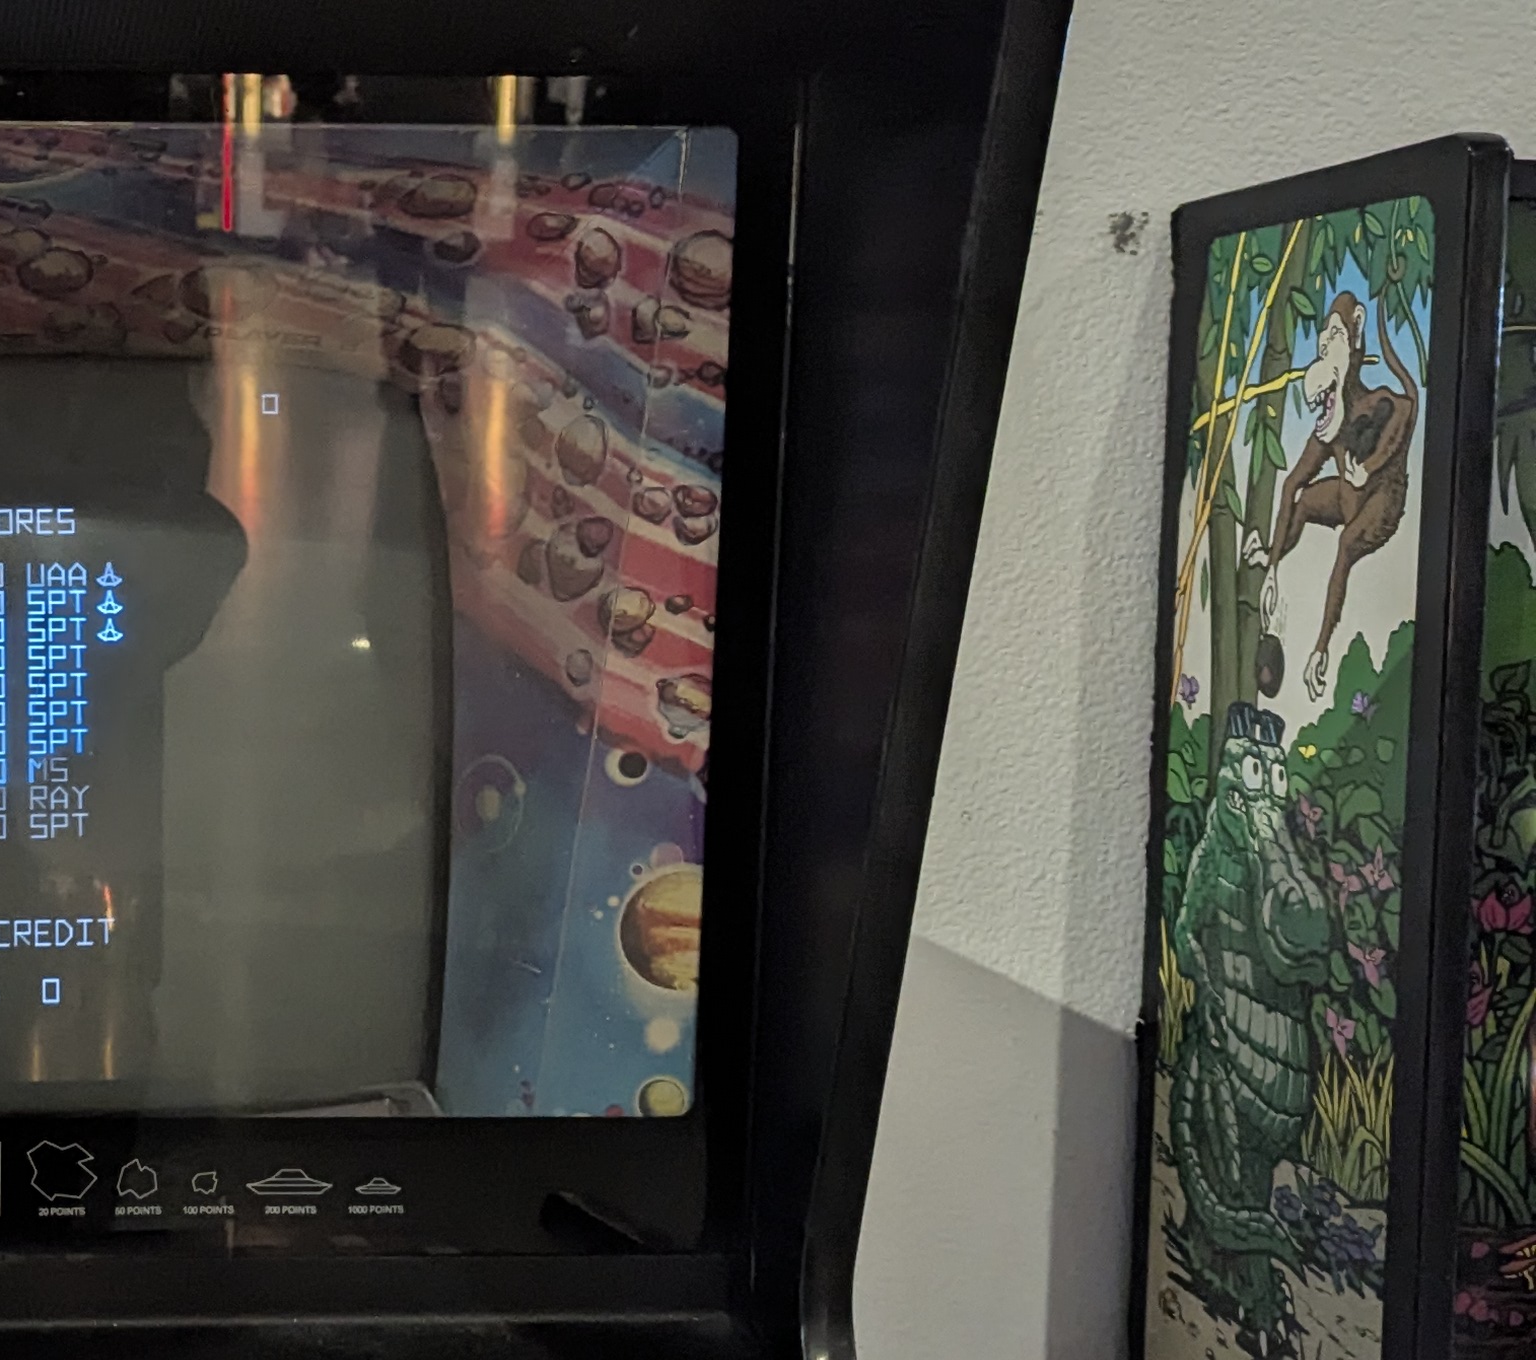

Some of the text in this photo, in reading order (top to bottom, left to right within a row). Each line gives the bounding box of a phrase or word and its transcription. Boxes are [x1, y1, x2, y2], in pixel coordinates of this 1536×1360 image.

[27, 562, 87, 587] UAA
[27, 590, 87, 615] SPT
[27, 617, 87, 642] SPT
[27, 645, 87, 670] SPT
[27, 672, 87, 698] SPT
[27, 700, 88, 726] SPT
[27, 728, 88, 754] SPT
[27, 757, 68, 783] MS
[28, 785, 89, 810] RAY
[29, 813, 89, 838] SPT
[41, 976, 61, 1005] 0
[38, 1207, 86, 1217] 20 POINTS
[127, 1206, 162, 1216] POINTS
[183, 1205, 234, 1215] 100 POINTS
[282, 1205, 317, 1215] POINTS
[348, 1204, 404, 1214] 1000 POINTS
